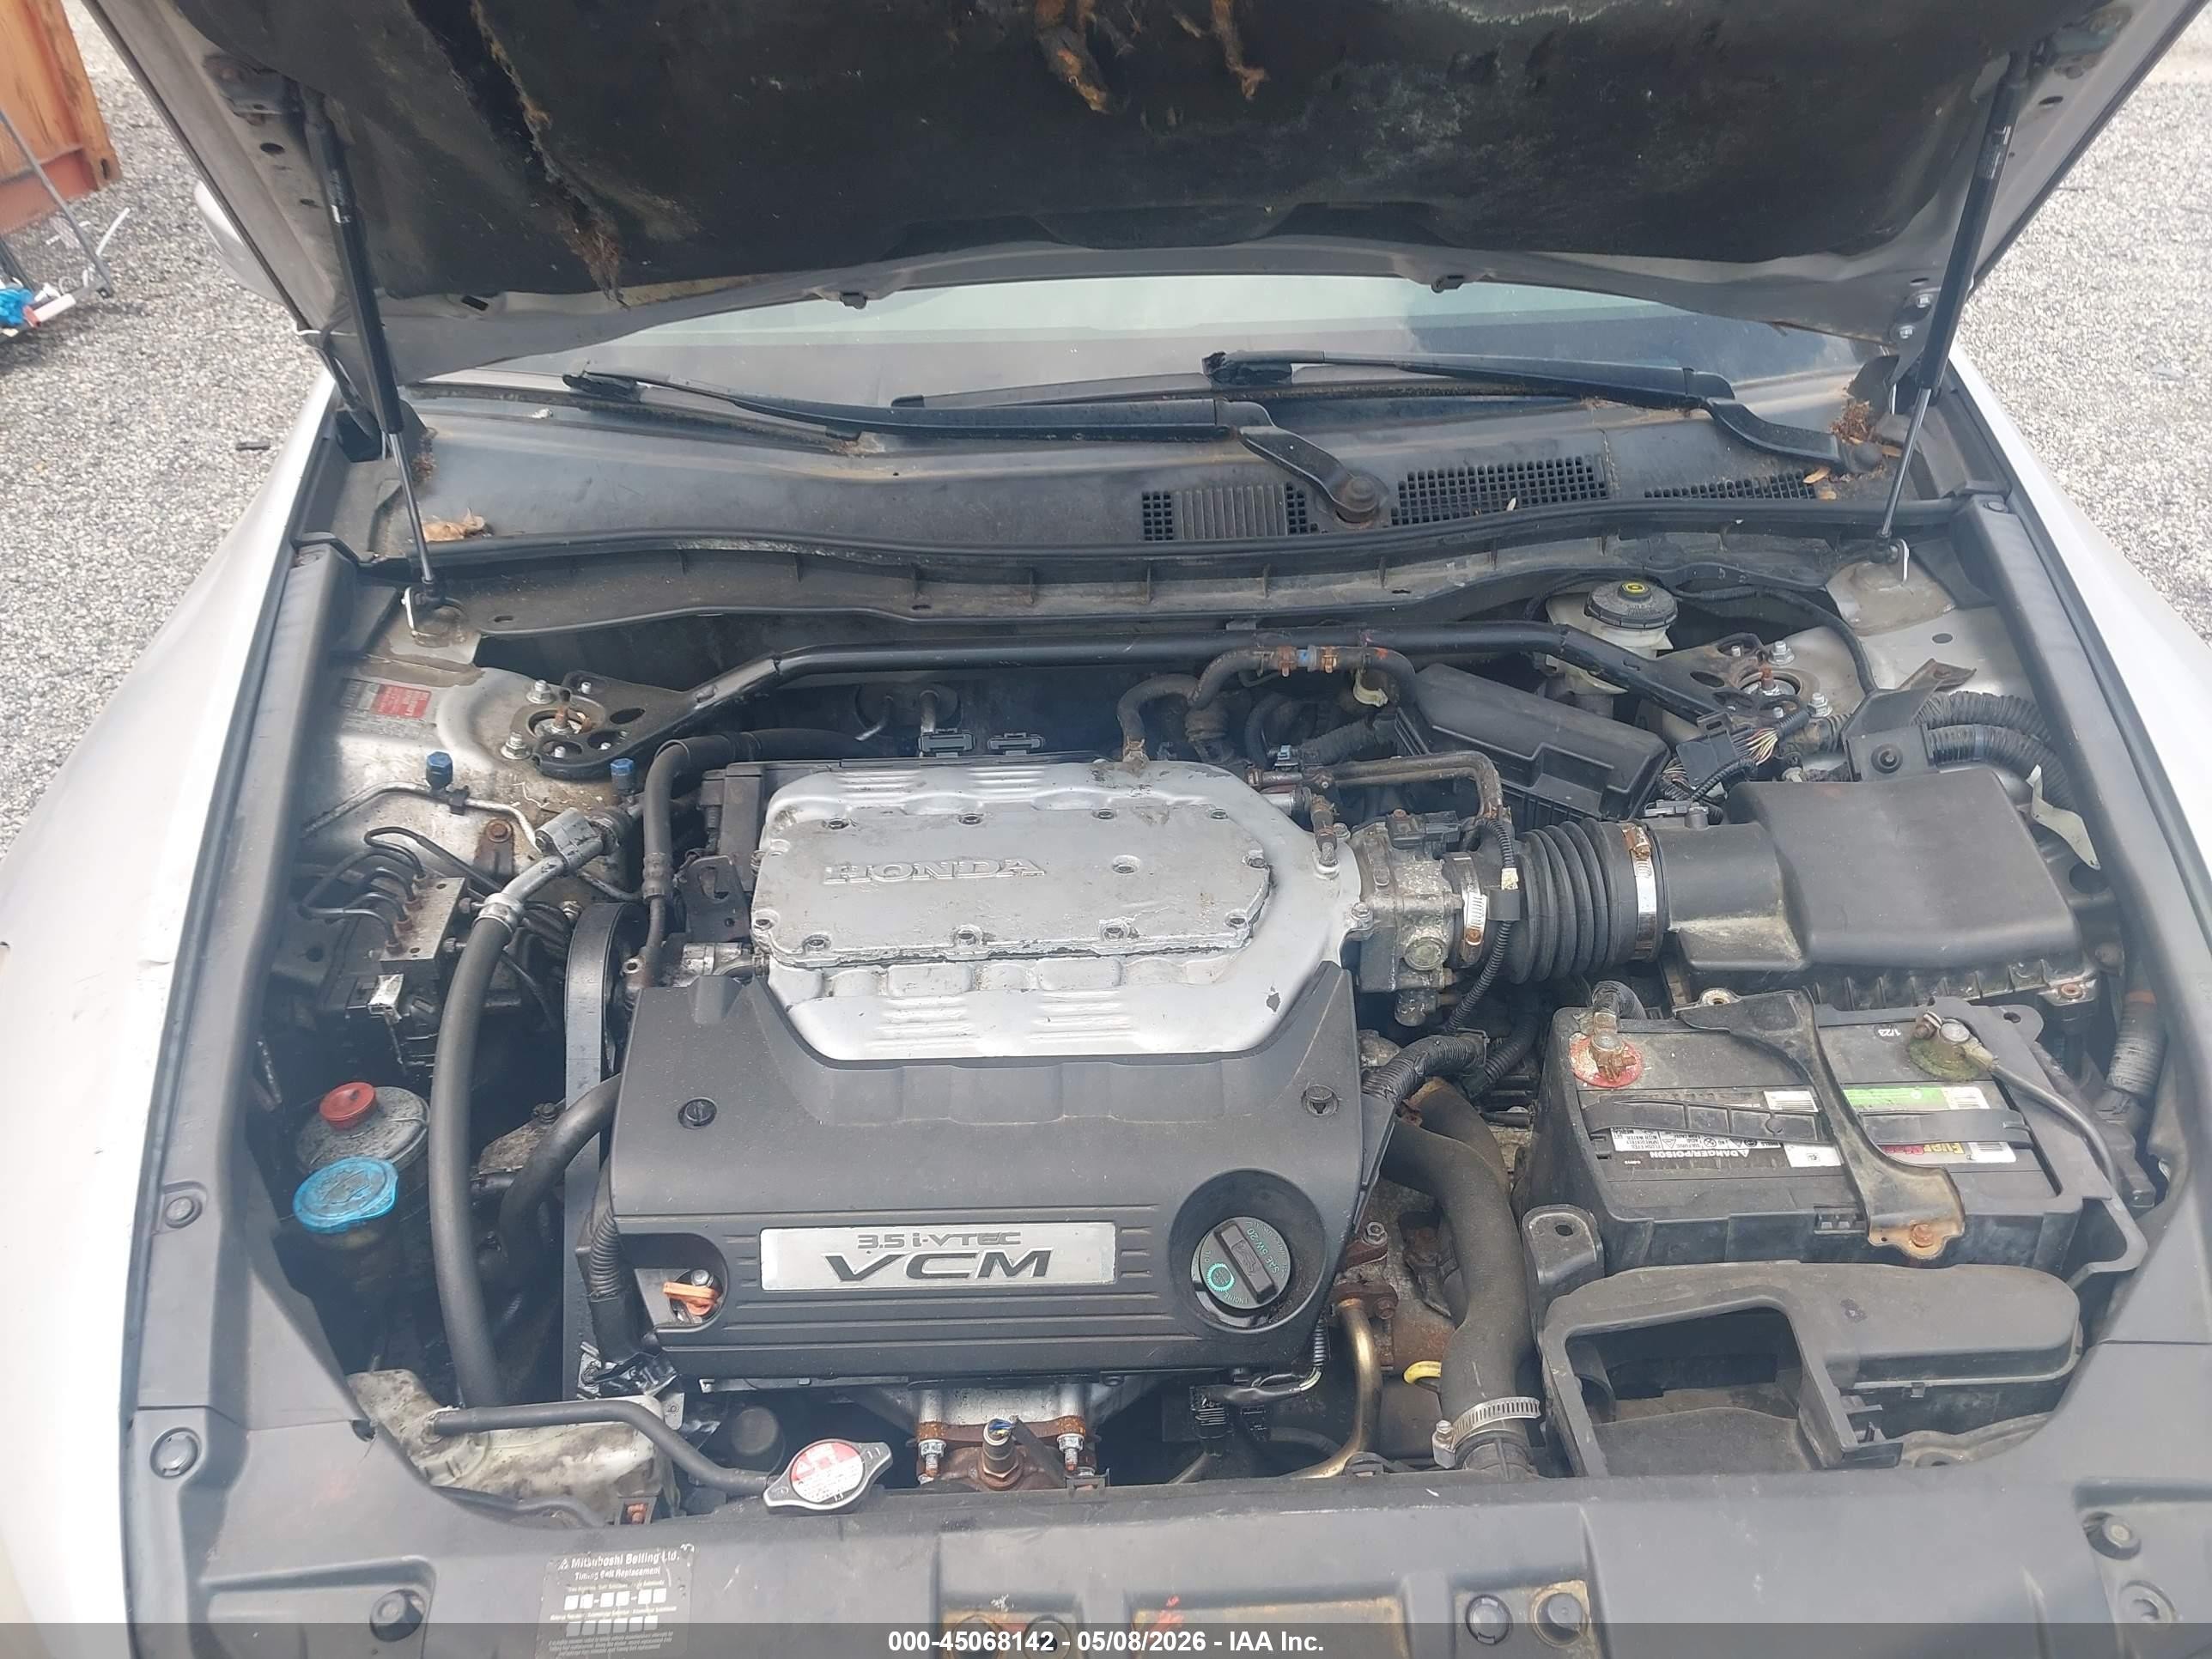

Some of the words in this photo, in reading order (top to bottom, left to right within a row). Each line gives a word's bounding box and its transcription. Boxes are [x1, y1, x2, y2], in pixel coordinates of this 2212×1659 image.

[823, 858, 1046, 884] HONDA
[1650, 1150, 1739, 1158] DANGER/POISON
[858, 1234, 904, 1249] 3.5
[912, 1231, 1022, 1248] i-VTEC
[824, 1248, 1054, 1282] VCM
[1265, 1255, 1280, 1273] SAE
[615, 1566, 660, 1578] Replacement
